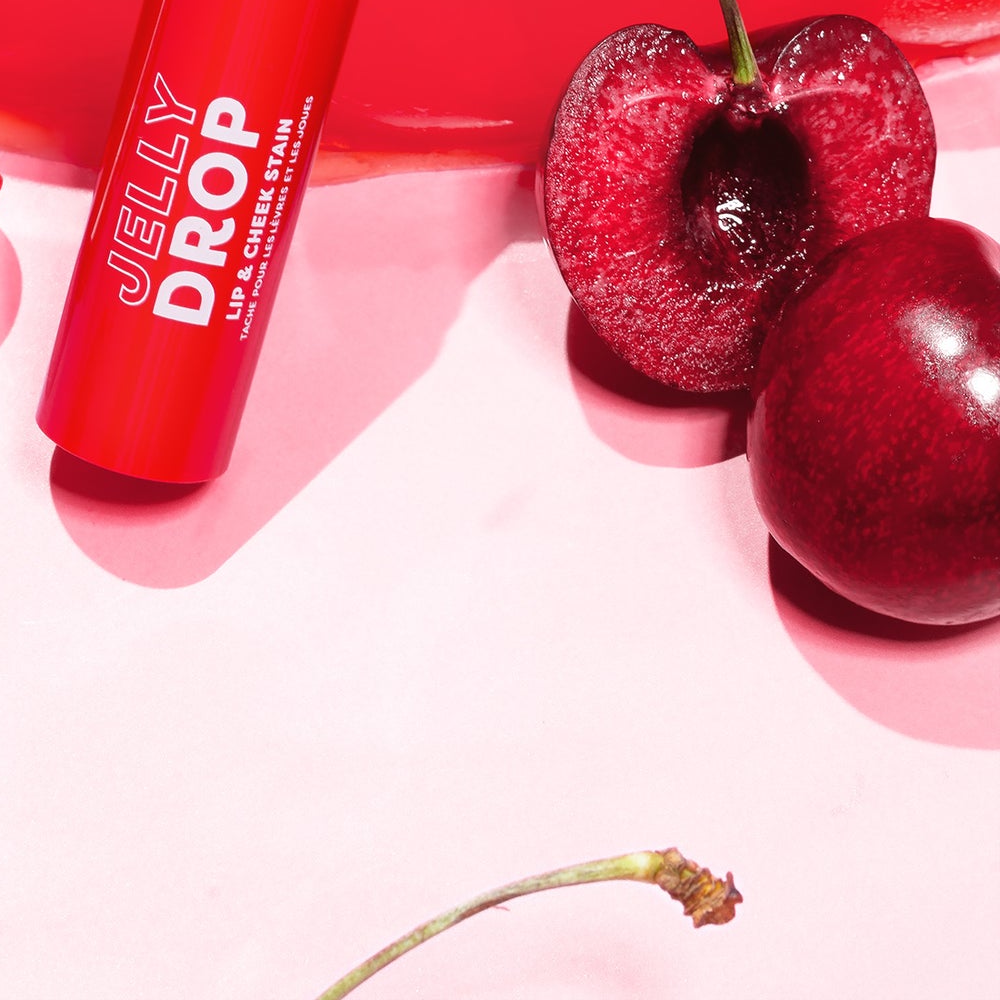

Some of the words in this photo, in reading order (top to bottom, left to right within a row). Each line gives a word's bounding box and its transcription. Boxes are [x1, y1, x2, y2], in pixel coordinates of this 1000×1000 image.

[264, 118, 293, 182] STAIN
[107, 72, 197, 306] JELLY
[152, 96, 260, 327] DROP
[240, 301, 257, 341] TACHE
[252, 260, 268, 297] POUR
[263, 235, 275, 258] LES
[284, 167, 294, 182] ET
[289, 140, 301, 164] LES
[297, 95, 314, 138] JOUES
[244, 187, 275, 260] CHEEK
[226, 286, 246, 321] LIP
[237, 265, 254, 282] &
